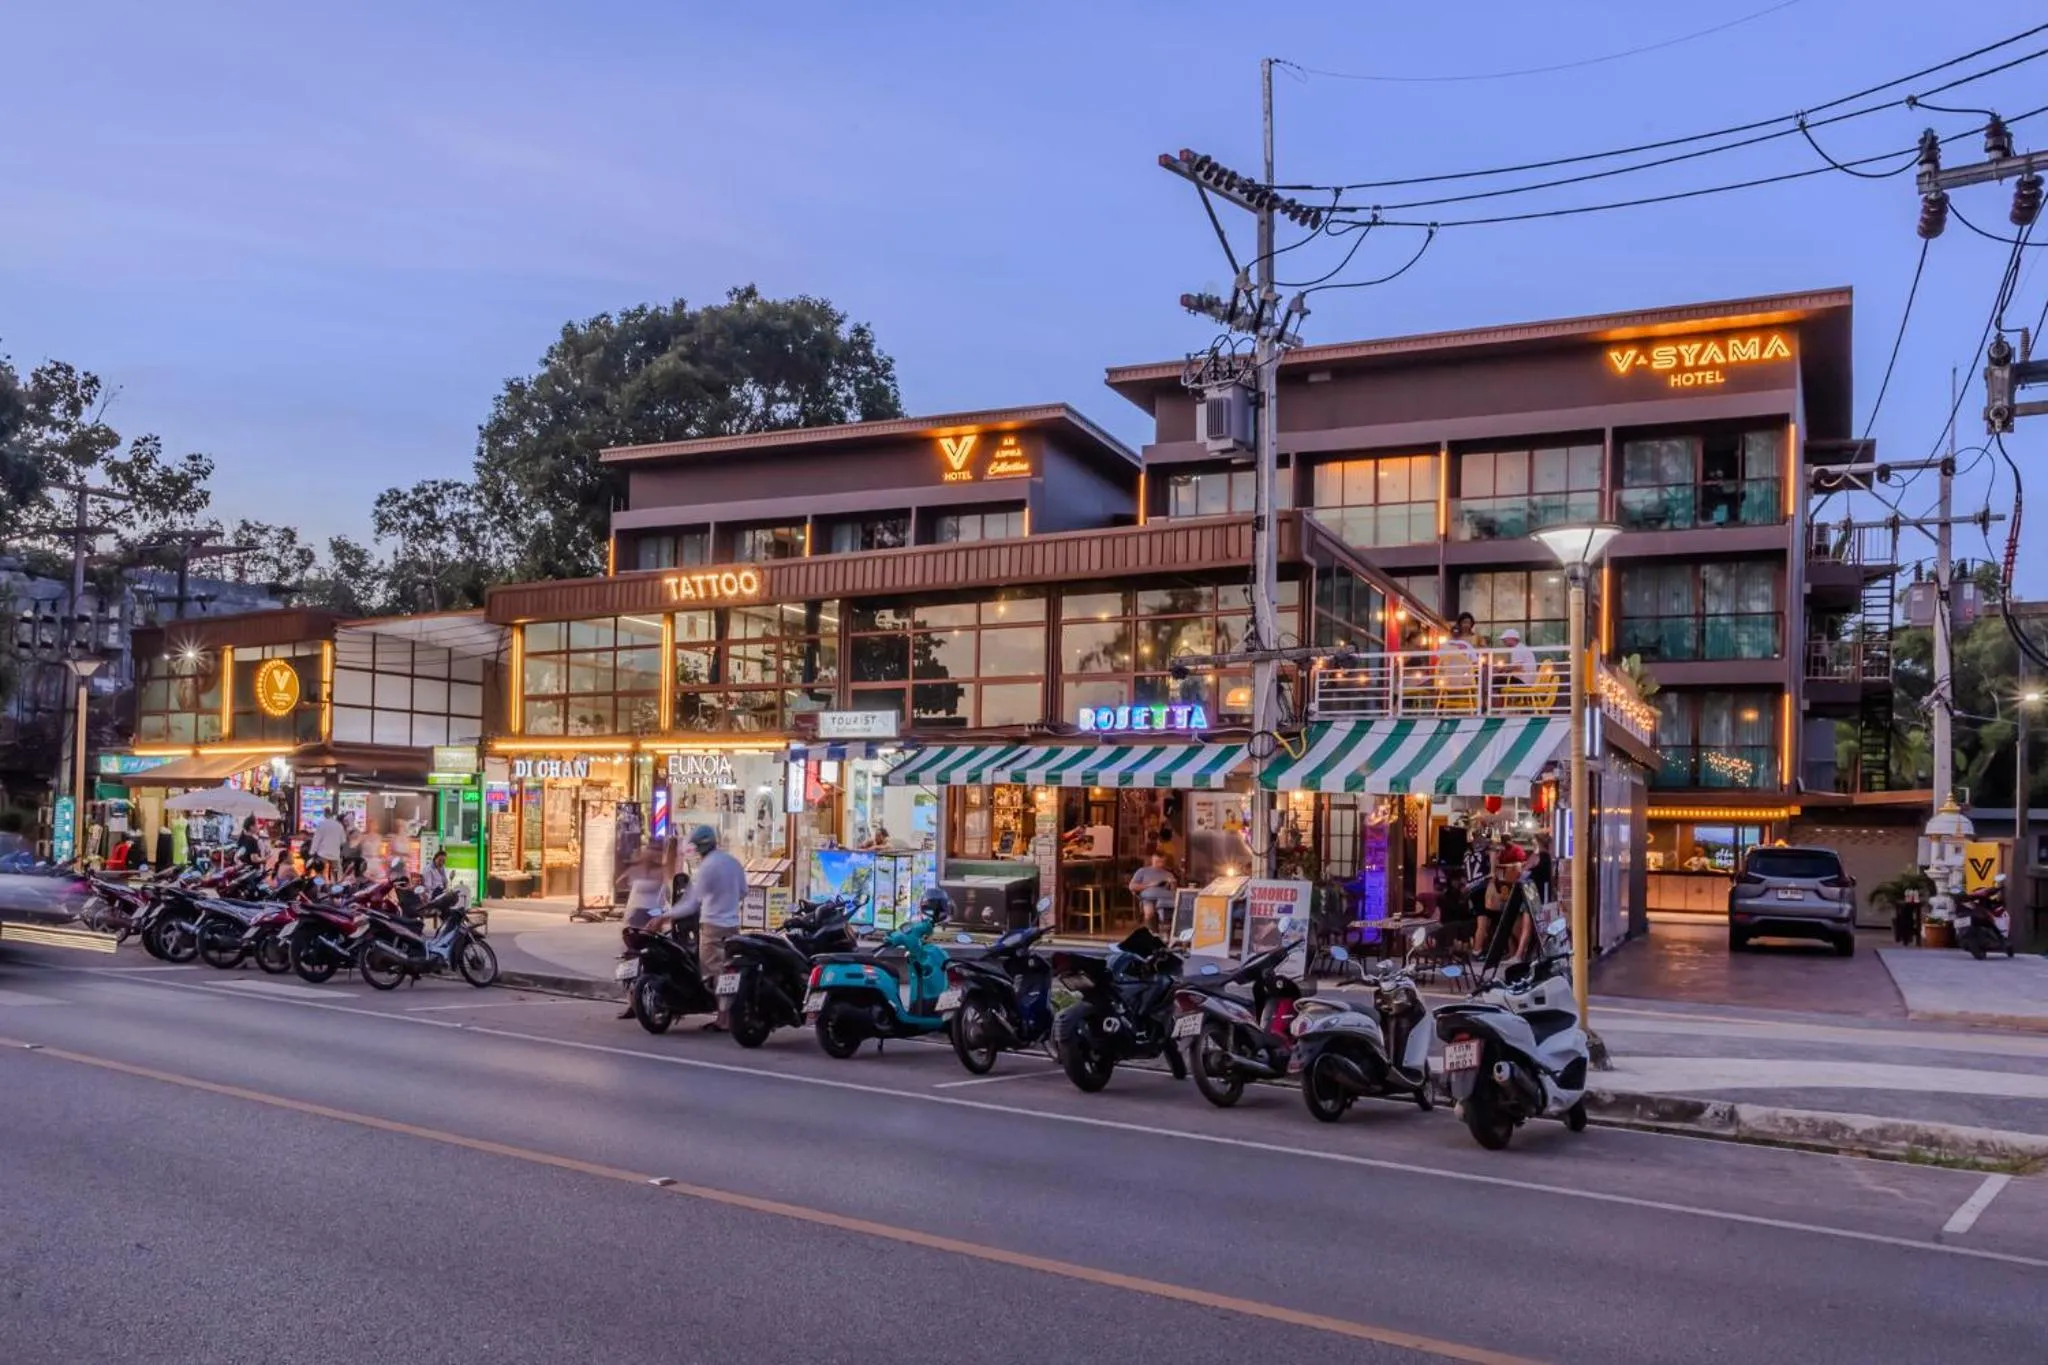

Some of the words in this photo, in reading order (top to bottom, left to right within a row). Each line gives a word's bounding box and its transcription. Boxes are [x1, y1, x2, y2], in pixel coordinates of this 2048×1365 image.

[1670, 371, 1725, 387] HOTEL
[939, 434, 977, 470] V
[943, 471, 973, 480] HOTEL
[663, 571, 758, 600] TATTOO
[272, 669, 291, 690] V
[831, 715, 877, 726] TOURIST
[1078, 703, 1208, 731] ROSETTA
[515, 760, 532, 777] DI
[537, 760, 588, 778] CHAN
[667, 754, 732, 776] EUNOIA
[1464, 852, 1483, 880] 12
[1968, 857, 1995, 880] V
[1250, 887, 1298, 901] SMOKED
[1250, 902, 1275, 916] BEEF
